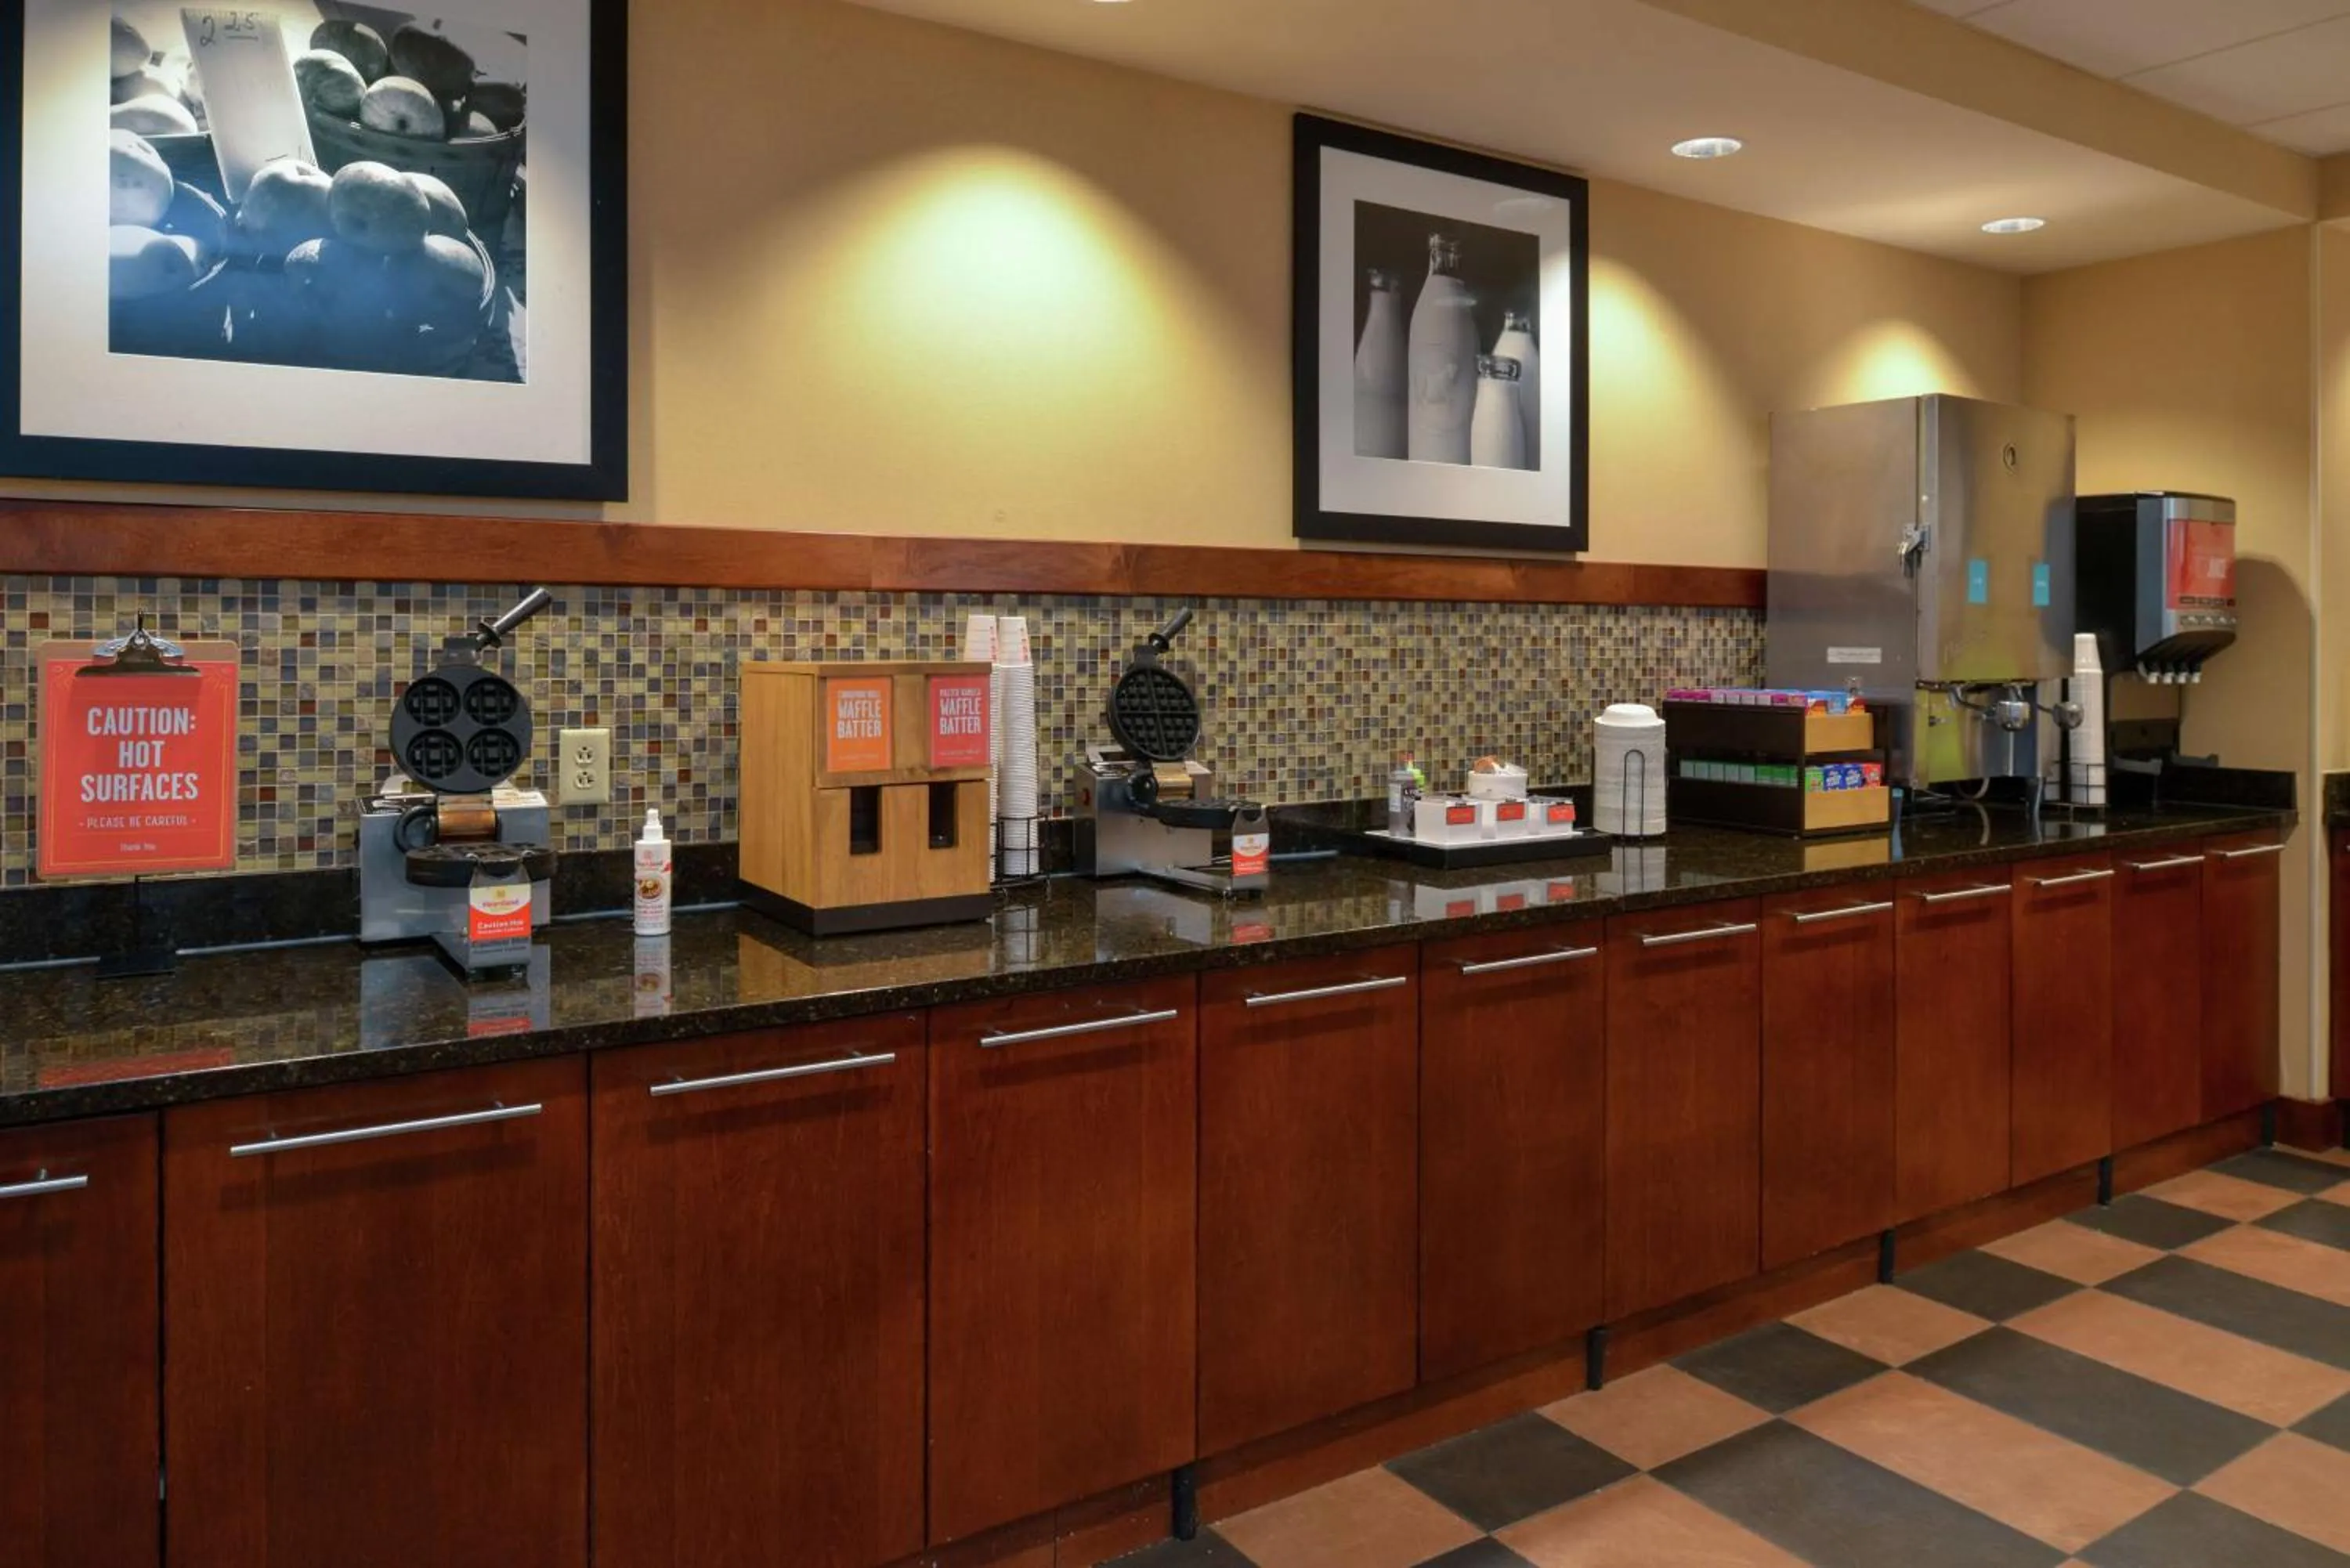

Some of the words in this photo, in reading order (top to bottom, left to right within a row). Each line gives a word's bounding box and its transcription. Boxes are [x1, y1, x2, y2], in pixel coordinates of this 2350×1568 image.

[837, 699, 881, 719] WAFFLE
[939, 697, 982, 716] WAFFLE
[87, 706, 196, 735] CAUTION:
[837, 718, 882, 739] BATTER
[939, 716, 982, 735] BATTER
[118, 740, 165, 768] HOT
[81, 772, 199, 803] SURFACES
[87, 815, 125, 829] PLEASE
[128, 815, 142, 828] BE
[145, 814, 188, 826] CAREFUL
